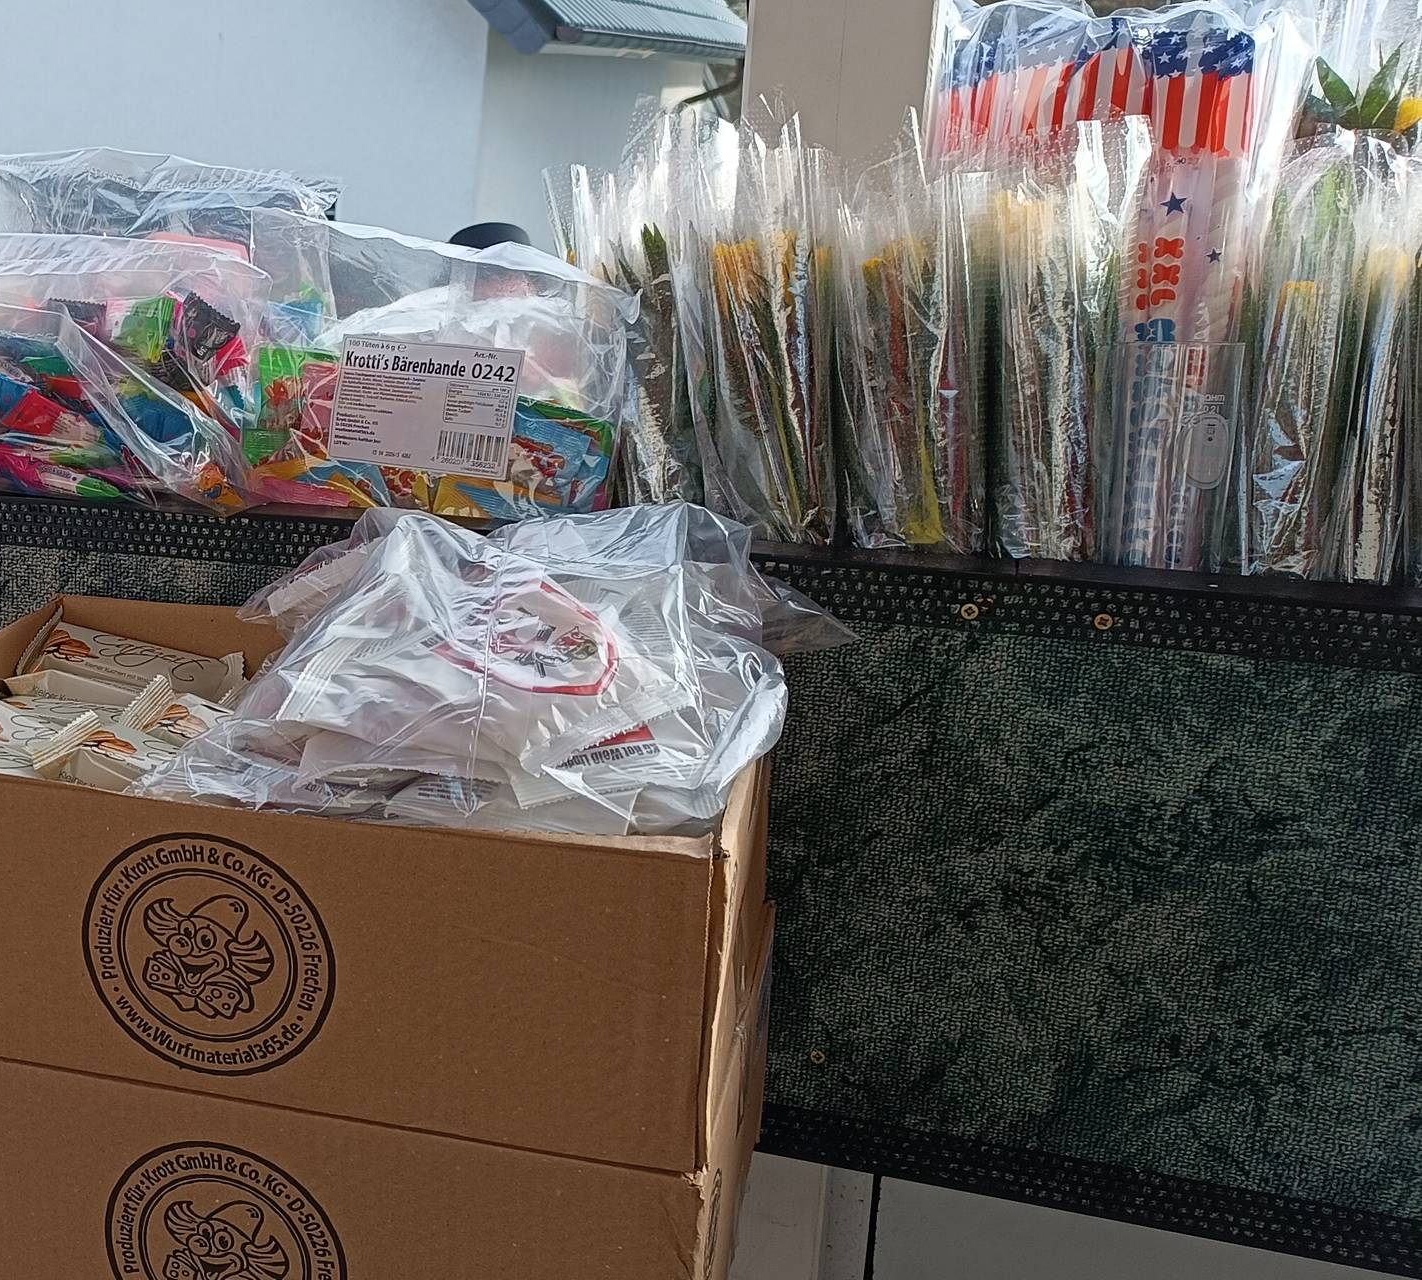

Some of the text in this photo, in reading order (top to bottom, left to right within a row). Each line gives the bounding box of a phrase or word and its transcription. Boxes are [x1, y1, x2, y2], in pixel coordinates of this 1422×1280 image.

[345, 350, 466, 378] Krotti's Bärenbande
[471, 362, 516, 382] 0242
[94, 905, 119, 980] Produziert
[120, 854, 159, 884] Krott
[155, 844, 205, 866] GmbH
[207, 847, 221, 864] &
[222, 852, 246, 876] Co.
[247, 863, 273, 889] KG
[272, 887, 318, 951] D-50226
[298, 953, 323, 1011] Frechen
[116, 995, 304, 1066] www.Wurfmaterial365.de
[116, 1201, 140, 1274] Produziert
[141, 1158, 179, 1186] Krott
[177, 1151, 222, 1171] GmbH
[224, 1157, 238, 1172] &
[239, 1161, 261, 1184] Co.
[261, 1173, 288, 1197] KG
[287, 1198, 333, 1256] D-50226
